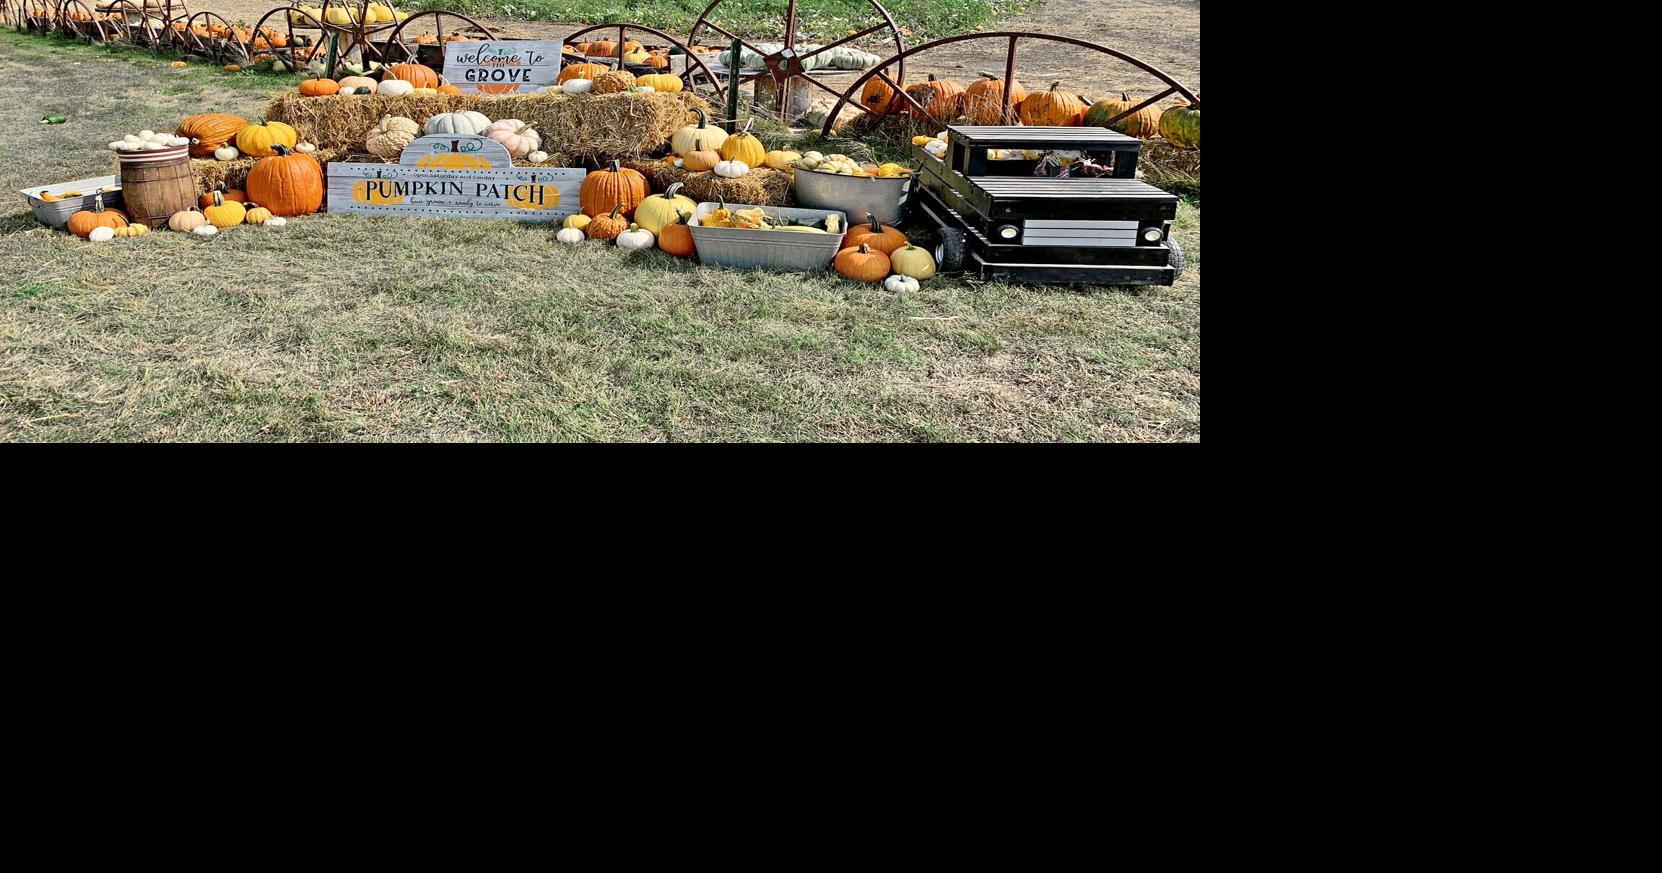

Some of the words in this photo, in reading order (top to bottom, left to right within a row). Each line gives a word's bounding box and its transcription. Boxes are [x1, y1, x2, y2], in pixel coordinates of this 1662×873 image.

[456, 43, 522, 66] welcome
[525, 50, 545, 66] to
[465, 68, 532, 82] GROVE
[366, 180, 464, 201] PUMPKIN
[476, 182, 544, 205] PATCH
[455, 199, 474, 208] ready
